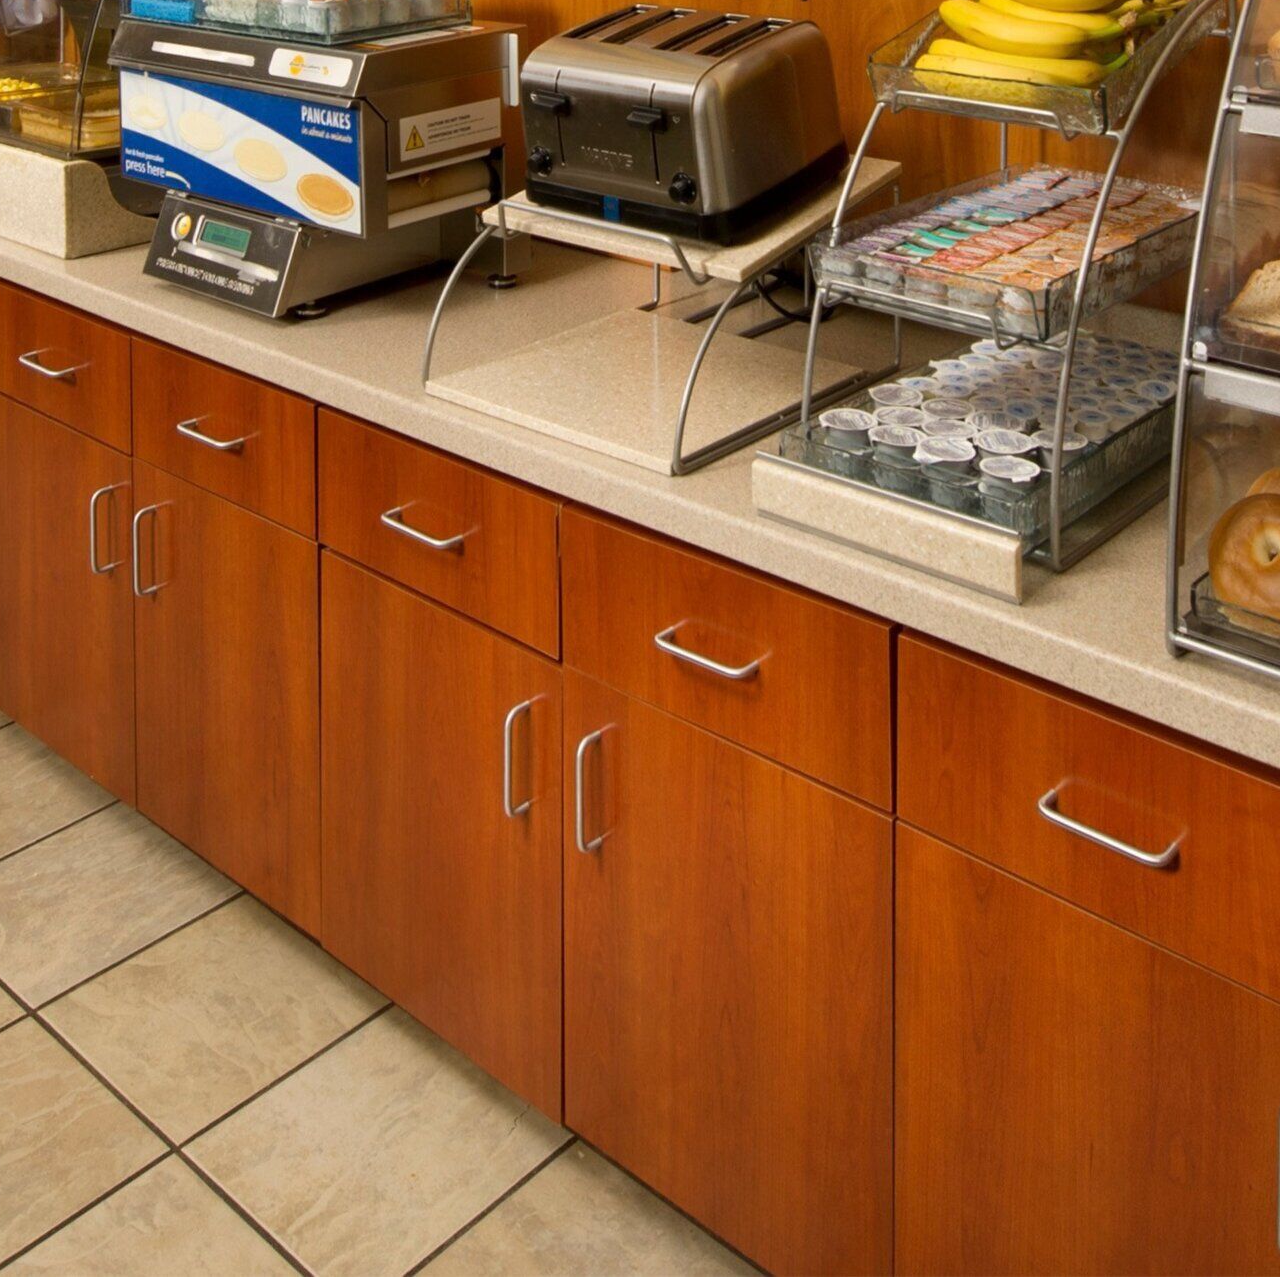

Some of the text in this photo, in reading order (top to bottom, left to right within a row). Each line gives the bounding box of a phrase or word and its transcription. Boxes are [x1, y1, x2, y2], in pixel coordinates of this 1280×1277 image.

[300, 105, 352, 131] PANCAKES
[125, 159, 165, 178] press here
